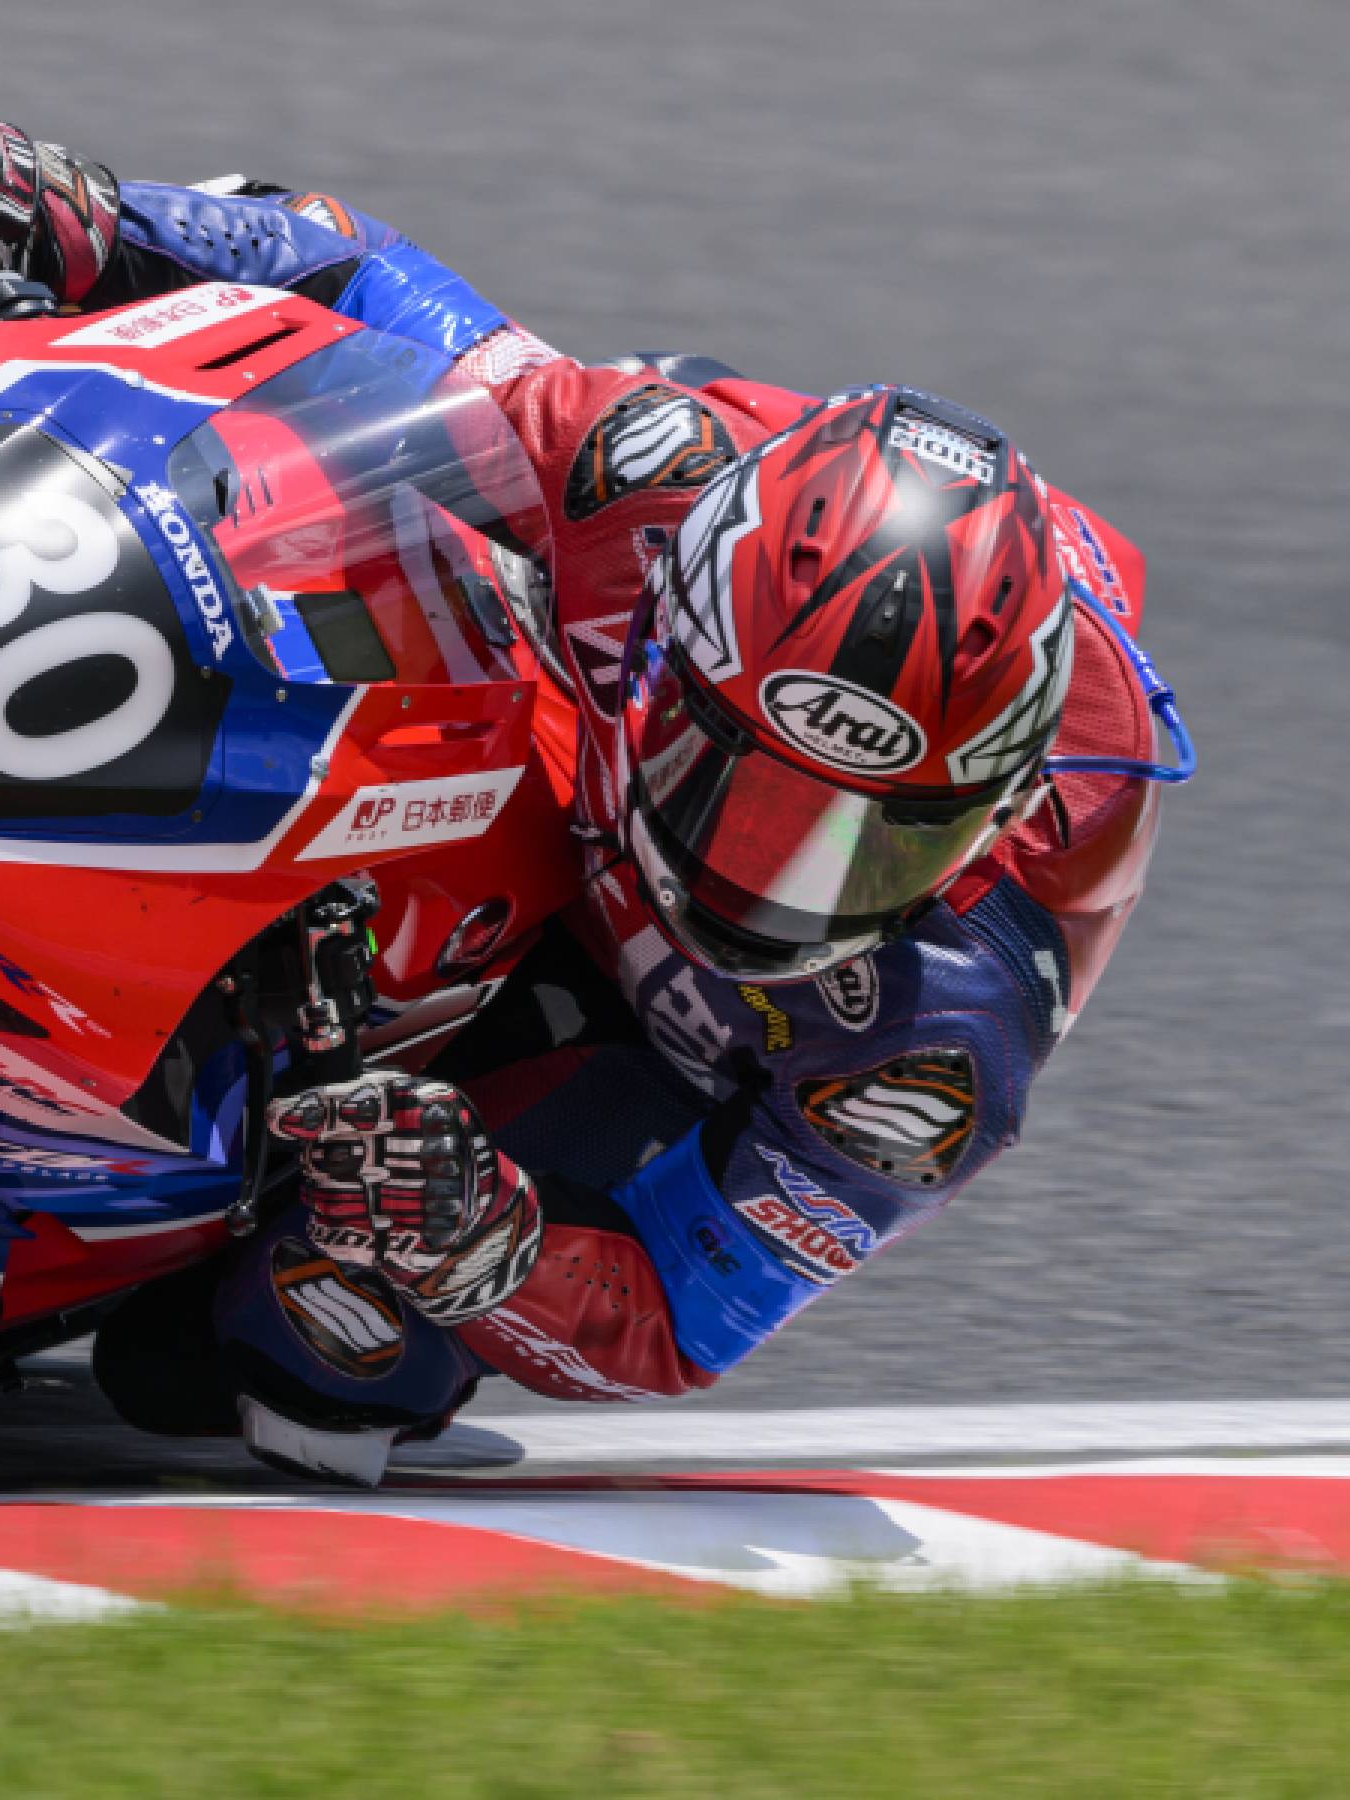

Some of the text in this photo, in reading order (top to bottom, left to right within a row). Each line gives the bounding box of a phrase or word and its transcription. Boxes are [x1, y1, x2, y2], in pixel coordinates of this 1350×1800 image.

[134, 481, 235, 661] HONDA
[774, 688, 907, 757] Arai
[401, 789, 498, 832] 日本郵便
